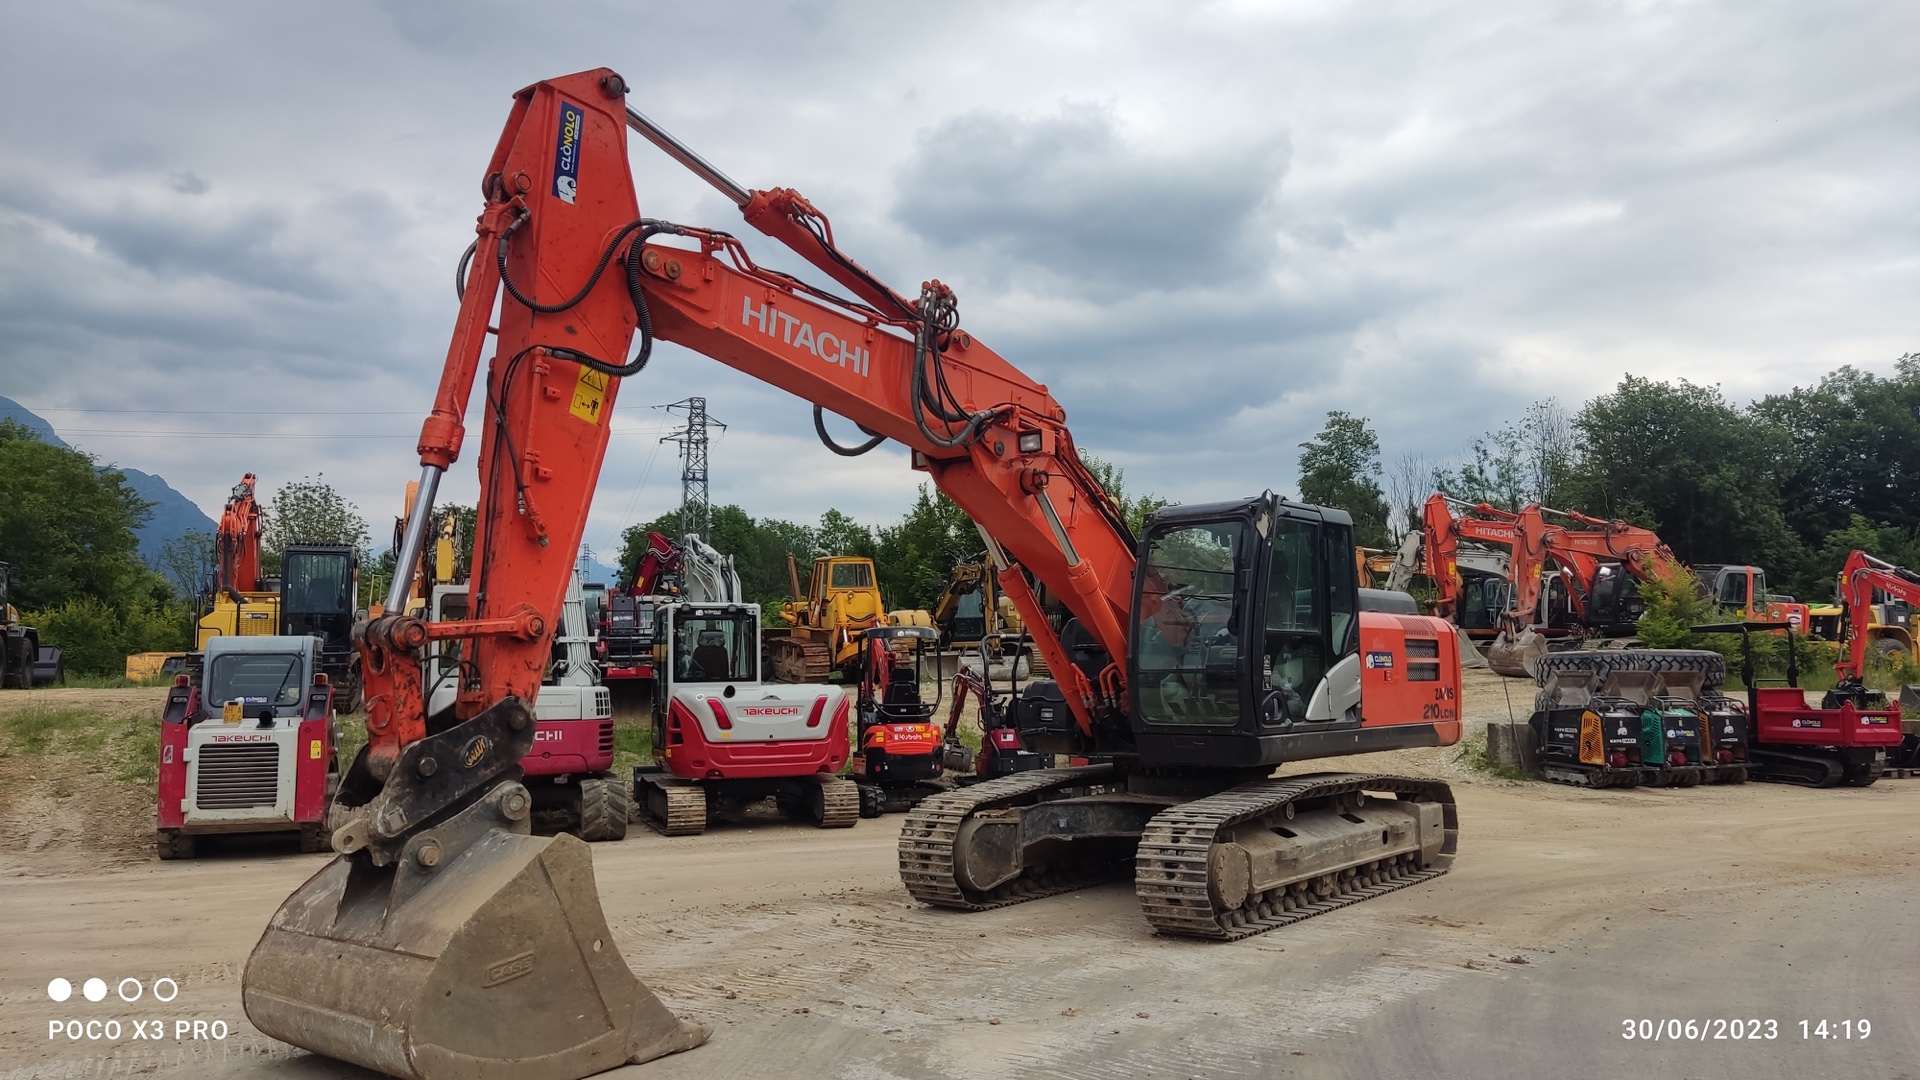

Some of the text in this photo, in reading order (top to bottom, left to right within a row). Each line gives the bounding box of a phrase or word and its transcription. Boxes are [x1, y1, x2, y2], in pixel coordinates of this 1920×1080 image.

[560, 110, 576, 171] CLÒNOLO
[742, 295, 870, 378] HITACHI
[1475, 527, 1514, 539] HITACHI
[743, 708, 798, 716] TAKEUCHI
